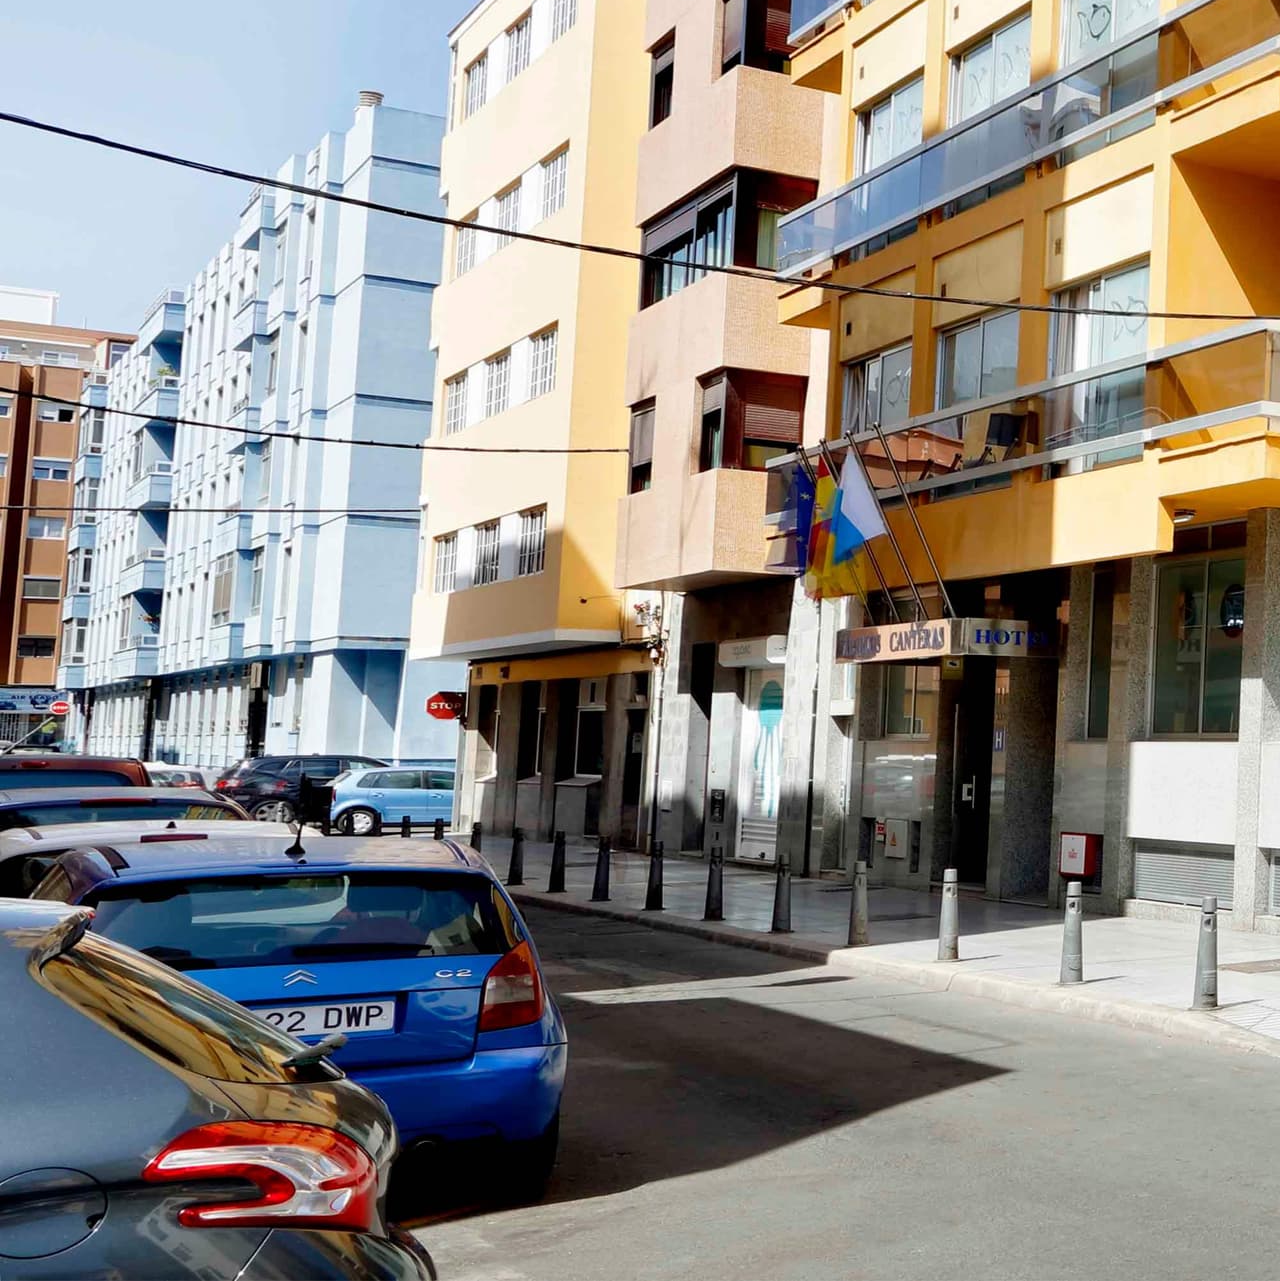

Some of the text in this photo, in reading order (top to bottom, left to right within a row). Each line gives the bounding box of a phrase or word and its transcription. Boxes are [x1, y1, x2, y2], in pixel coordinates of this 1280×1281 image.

[889, 625, 944, 652] CANTERAS
[430, 702, 461, 710] STOP
[434, 969, 473, 978] C2
[323, 1005, 384, 1029] DWP
